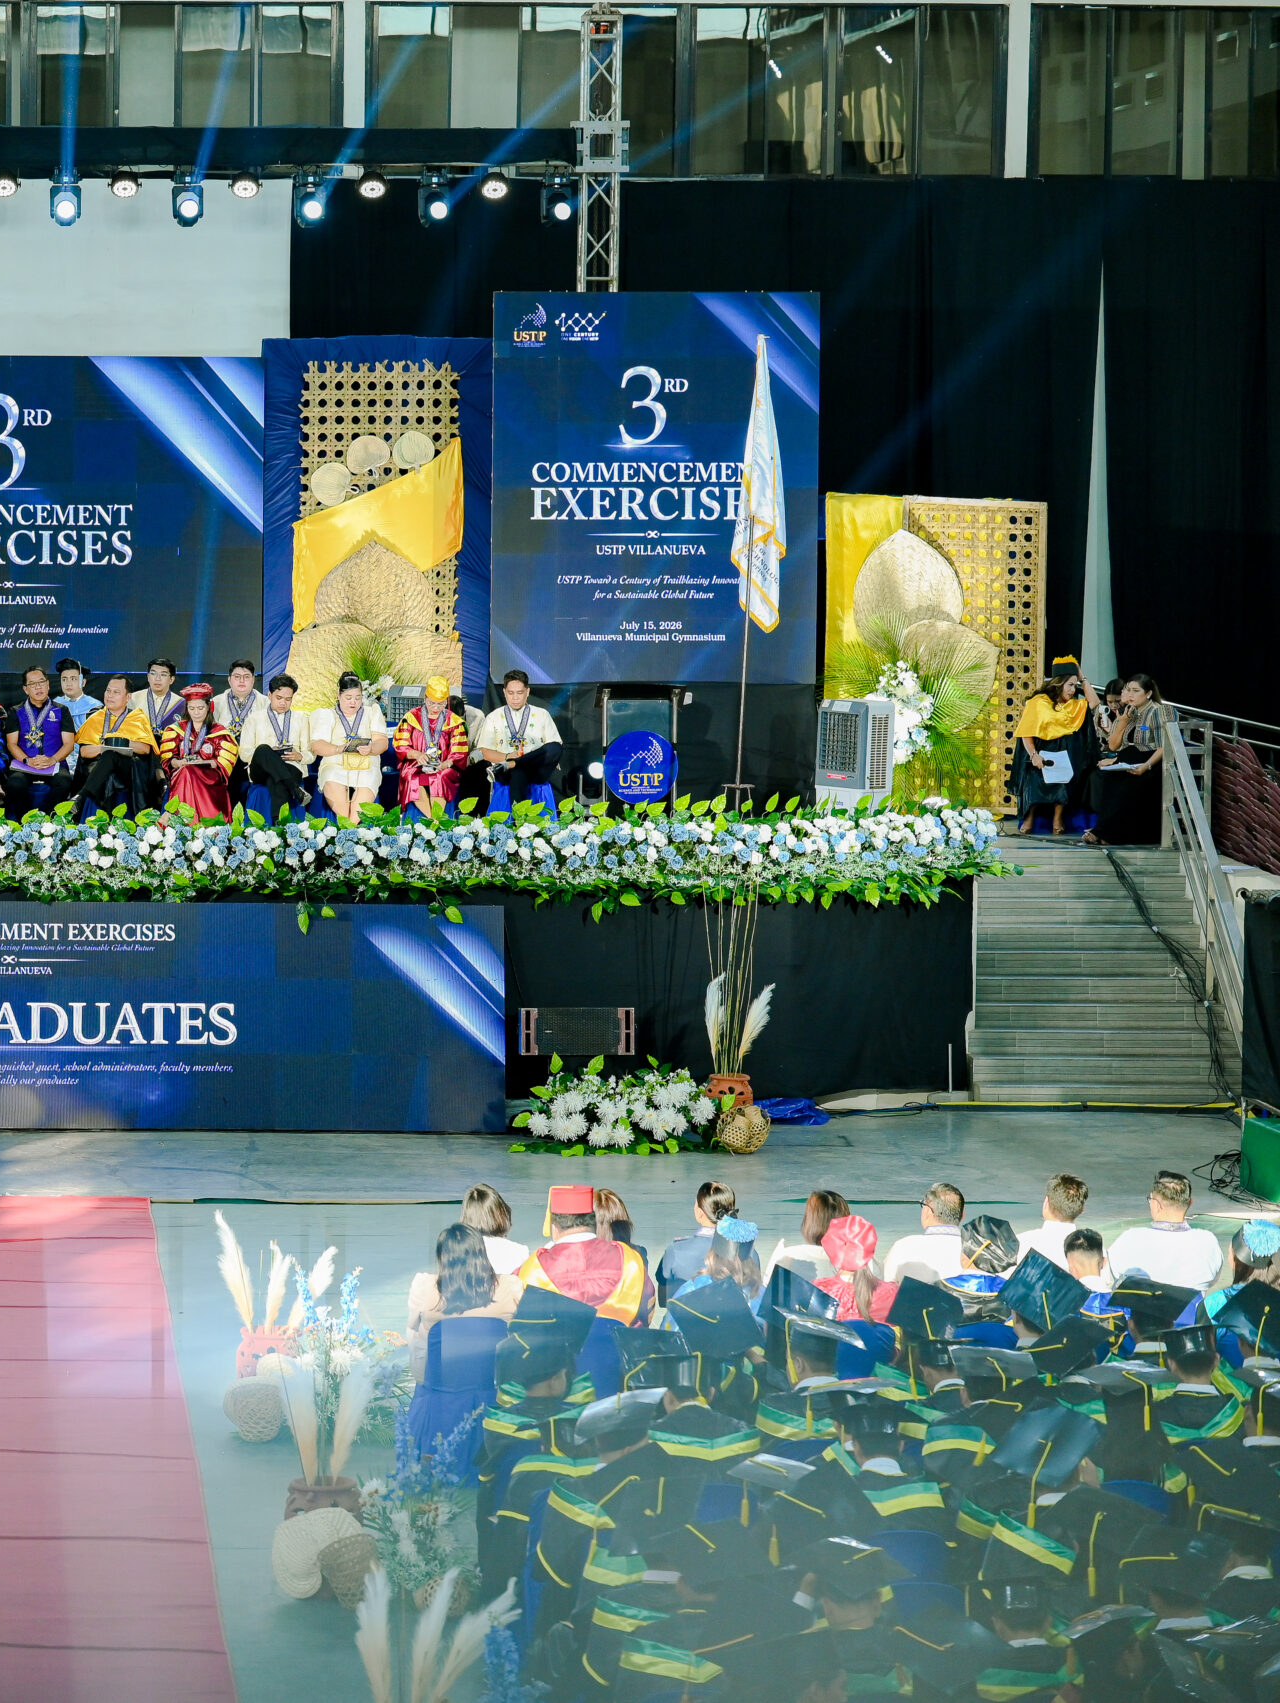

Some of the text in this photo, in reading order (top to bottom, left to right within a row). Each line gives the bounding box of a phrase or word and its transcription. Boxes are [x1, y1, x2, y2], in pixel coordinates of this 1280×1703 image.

[514, 331, 547, 341] USTP
[619, 366, 689, 445] 3RD
[531, 462, 744, 483] COMMENCEME
[530, 487, 742, 520] EXERCISE
[596, 545, 706, 555] USTP VILLANUEVA
[557, 575, 582, 585] USTP
[584, 575, 611, 585] Toward
[620, 575, 651, 587] Century
[652, 575, 661, 587] of
[663, 575, 709, 587] Trailblazing
[593, 590, 606, 600] for
[614, 589, 659, 599] Sustainable
[661, 589, 687, 599] Global
[689, 590, 714, 599] Future
[7, 624, 16, 635] of
[18, 624, 65, 635] Trailblazing
[67, 624, 108, 634] Innovation
[619, 621, 640, 631] July
[659, 621, 682, 630] 2026
[576, 632, 726, 643] Villanueva Municipal Gymnasium
[16, 639, 43, 649] Global
[44, 639, 70, 649] Future
[619, 772, 664, 786] USTP
[68, 923, 176, 941] EXERCISES
[21, 943, 55, 951] Innovation
[73, 943, 110, 951] Sustainable
[35, 1062, 61, 1073] guest,
[63, 1062, 90, 1072] school
[92, 1062, 157, 1073] administrators,
[159, 1062, 190, 1074] faculty
[192, 1062, 234, 1073] members,
[20, 1077, 35, 1085] our
[36, 1075, 79, 1087] graduates
